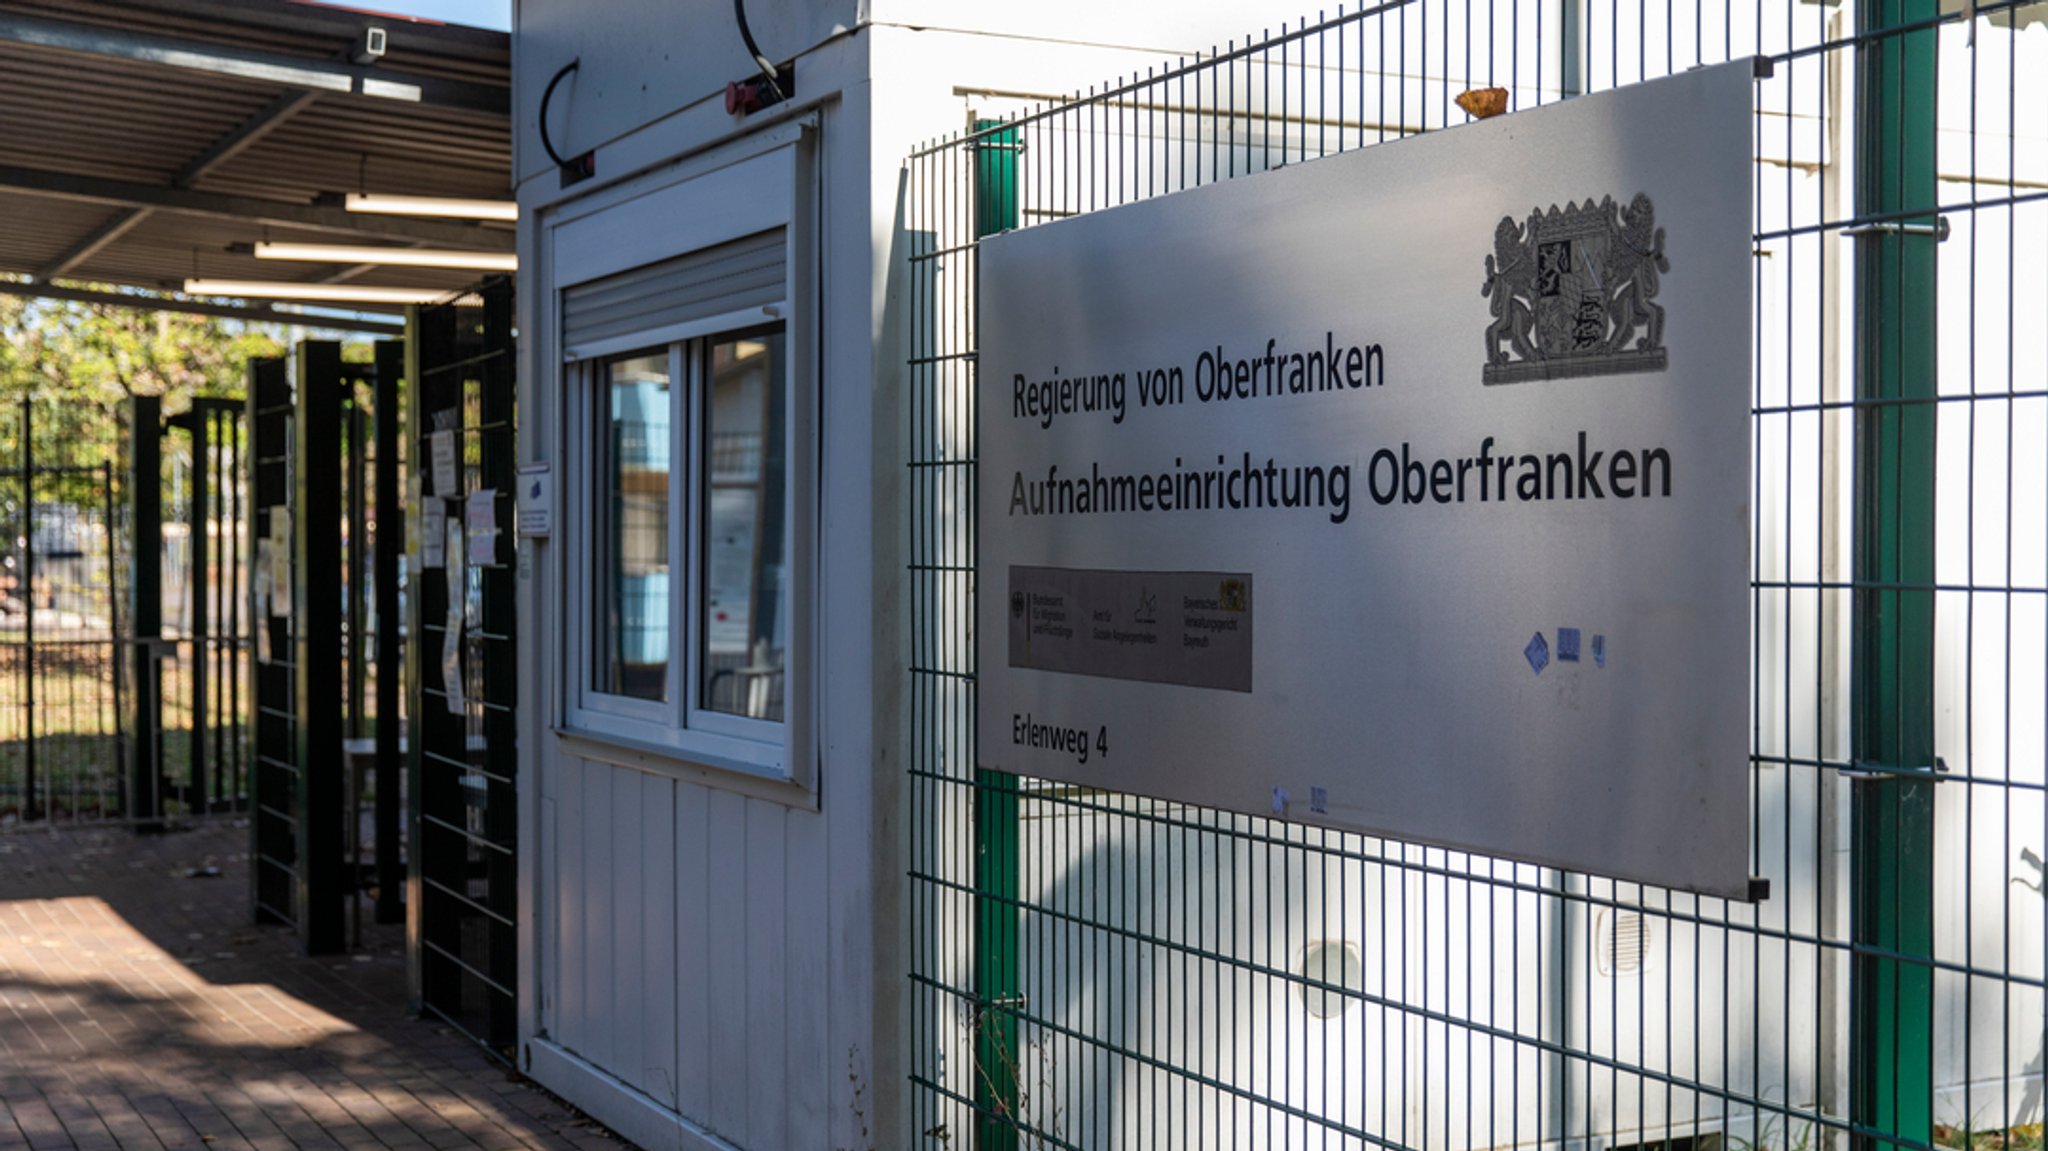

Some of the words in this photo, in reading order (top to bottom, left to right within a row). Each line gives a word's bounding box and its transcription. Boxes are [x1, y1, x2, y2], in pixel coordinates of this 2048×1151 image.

[1013, 366, 1126, 430] Regierung
[1137, 365, 1184, 407] von
[1195, 331, 1385, 402] Oberfranken
[1008, 452, 1350, 524] Aufnahmeeinrichtung
[1368, 431, 1672, 505] Oberfranken
[1013, 713, 1088, 764] Erlenweg
[1096, 725, 1108, 757] 4
